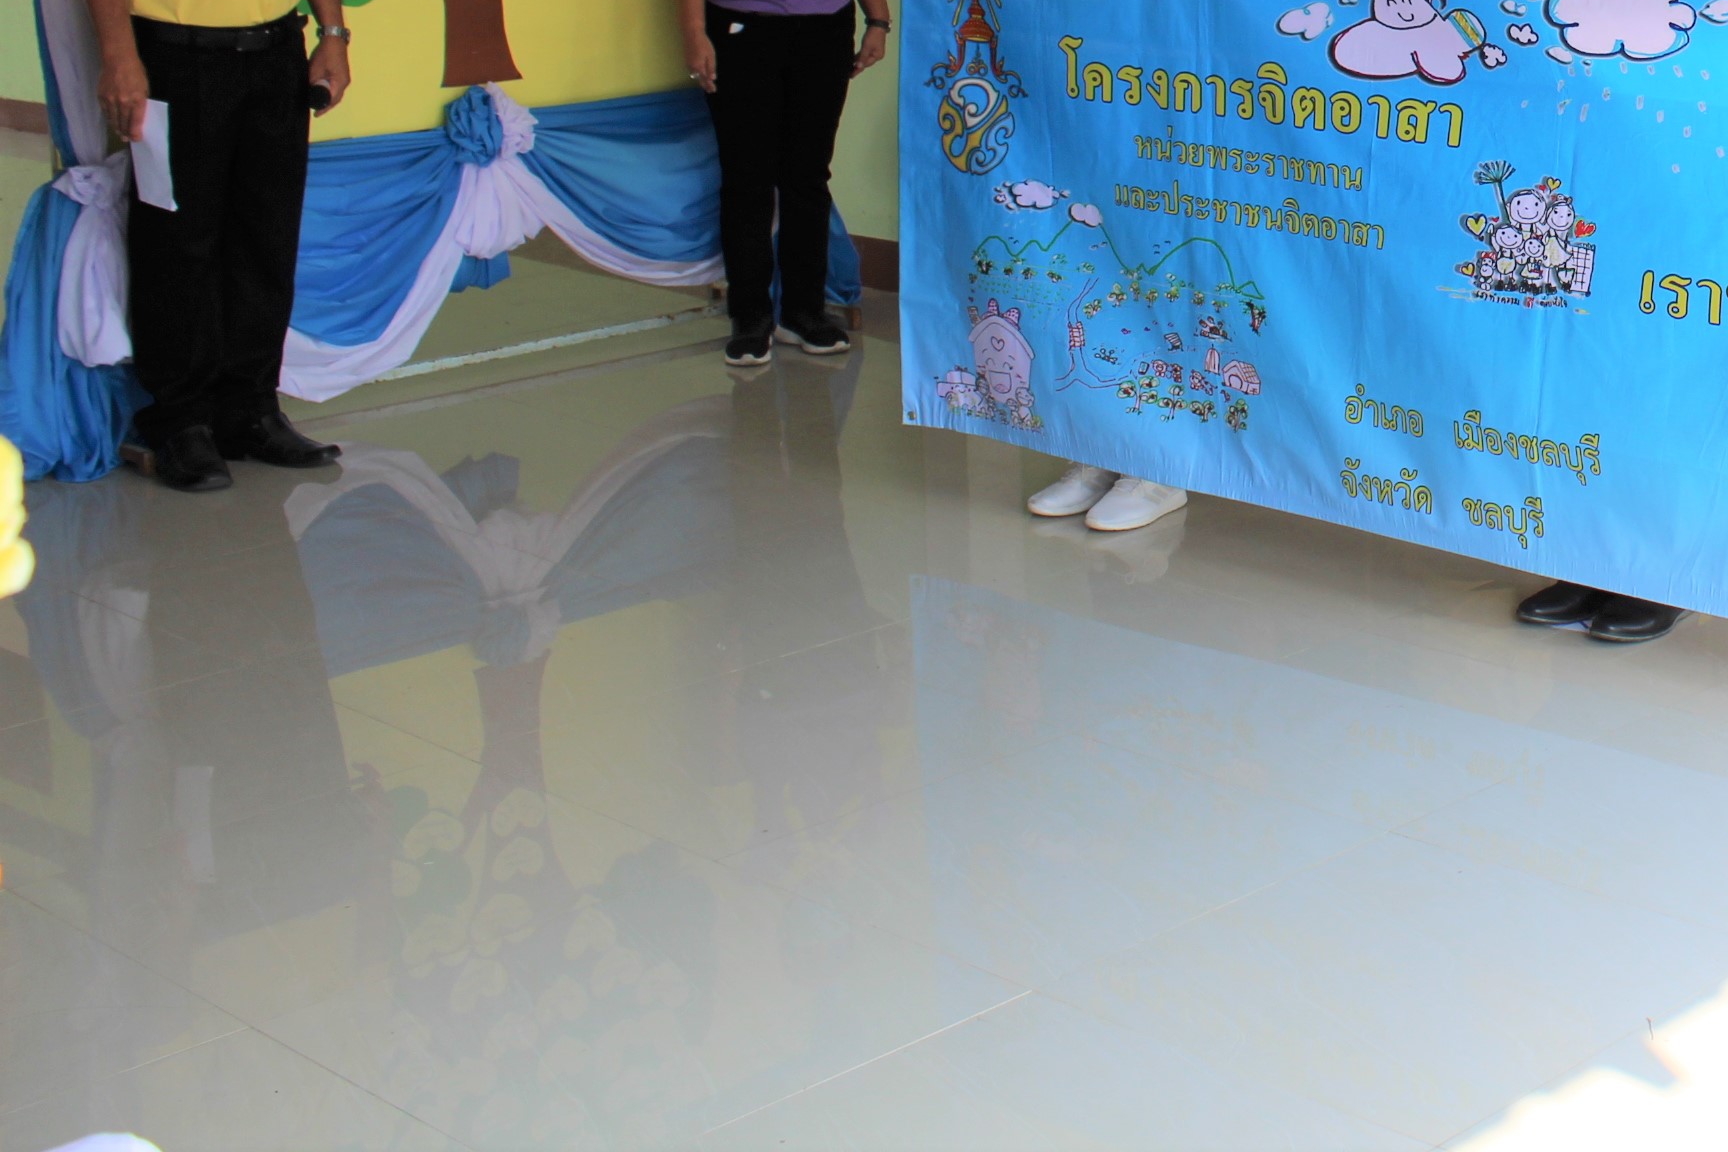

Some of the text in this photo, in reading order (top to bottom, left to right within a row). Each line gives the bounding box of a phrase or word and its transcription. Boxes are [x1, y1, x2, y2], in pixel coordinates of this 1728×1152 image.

[1058, 35, 1463, 148] โครงการจิตอาสา
[1132, 125, 1364, 192] หน่วยพระราชทาน
[1114, 180, 1386, 250] และประชาชนจิตอาสา
[1344, 383, 1602, 487] อำเภอ เมืองชลบุรี
[1340, 457, 1545, 549] จังหวัด ชลบุรี
